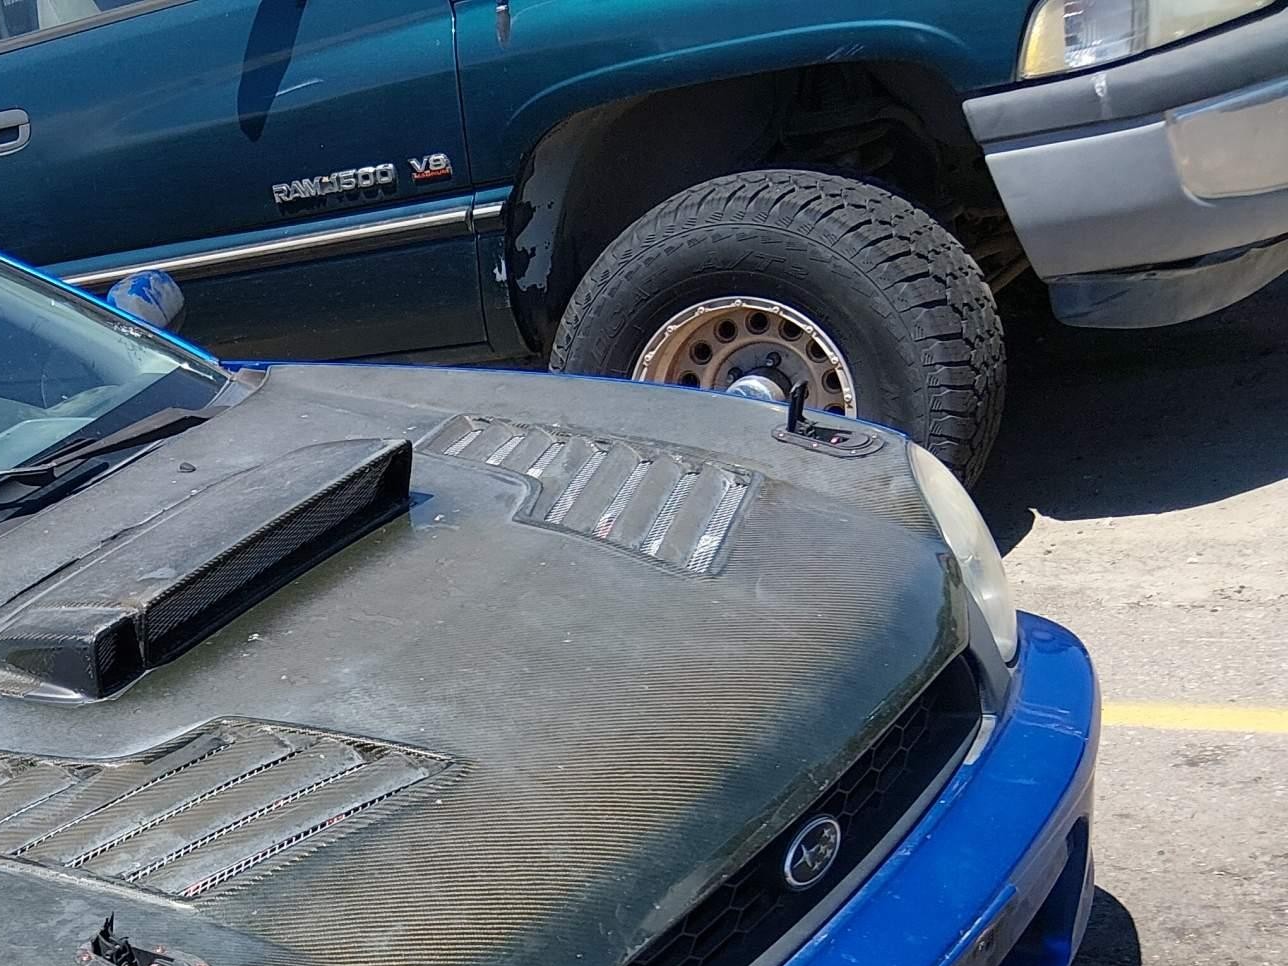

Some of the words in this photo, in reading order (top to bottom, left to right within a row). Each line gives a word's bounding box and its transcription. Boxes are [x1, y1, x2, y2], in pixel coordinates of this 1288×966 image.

[408, 153, 450, 173] V8
[272, 175, 326, 203] RAM
[326, 163, 396, 193] 1500
